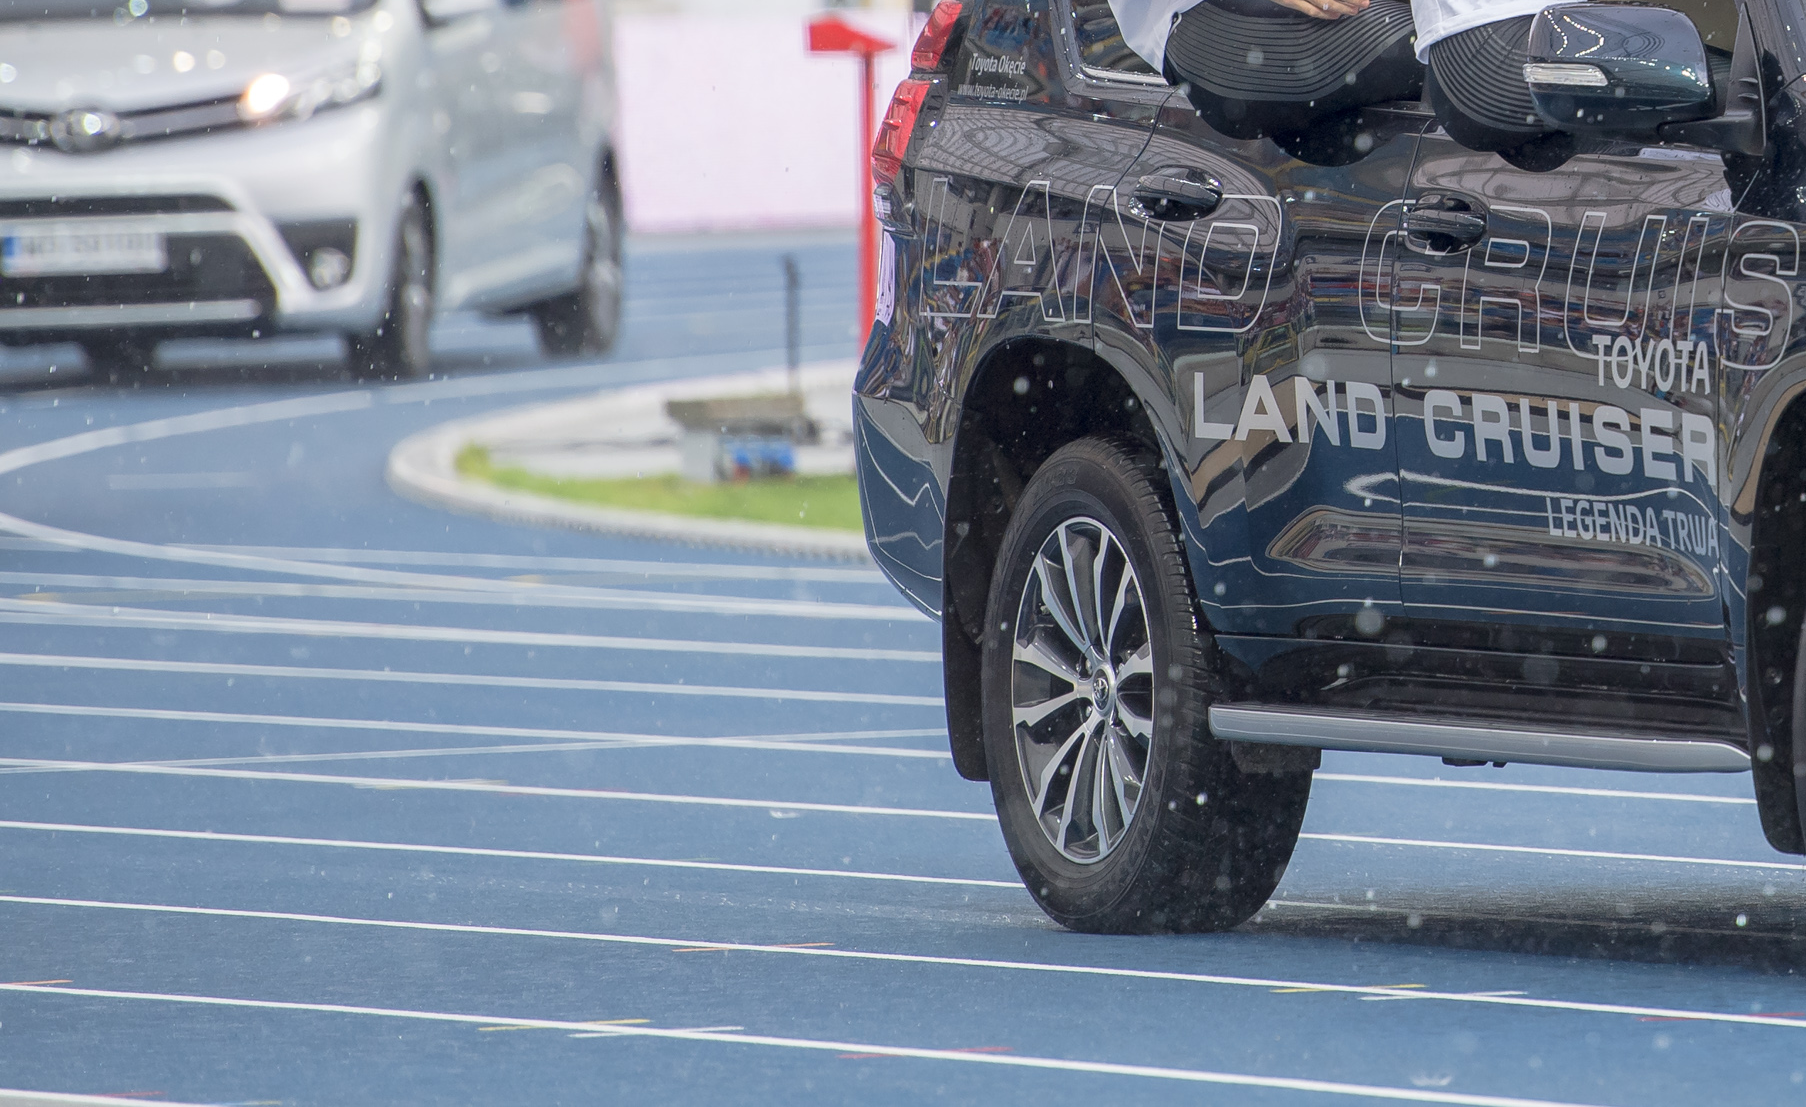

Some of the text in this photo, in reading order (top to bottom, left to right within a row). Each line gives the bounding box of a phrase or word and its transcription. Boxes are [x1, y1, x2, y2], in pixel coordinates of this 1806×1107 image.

[971, 52, 1027, 79] Toyota Okęcie
[919, 177, 1285, 333] LAND
[1592, 334, 1711, 395] TOYOTA
[1193, 371, 1717, 488] LAND CRUISER
[1546, 496, 1720, 559] LEGENDA TRWA
